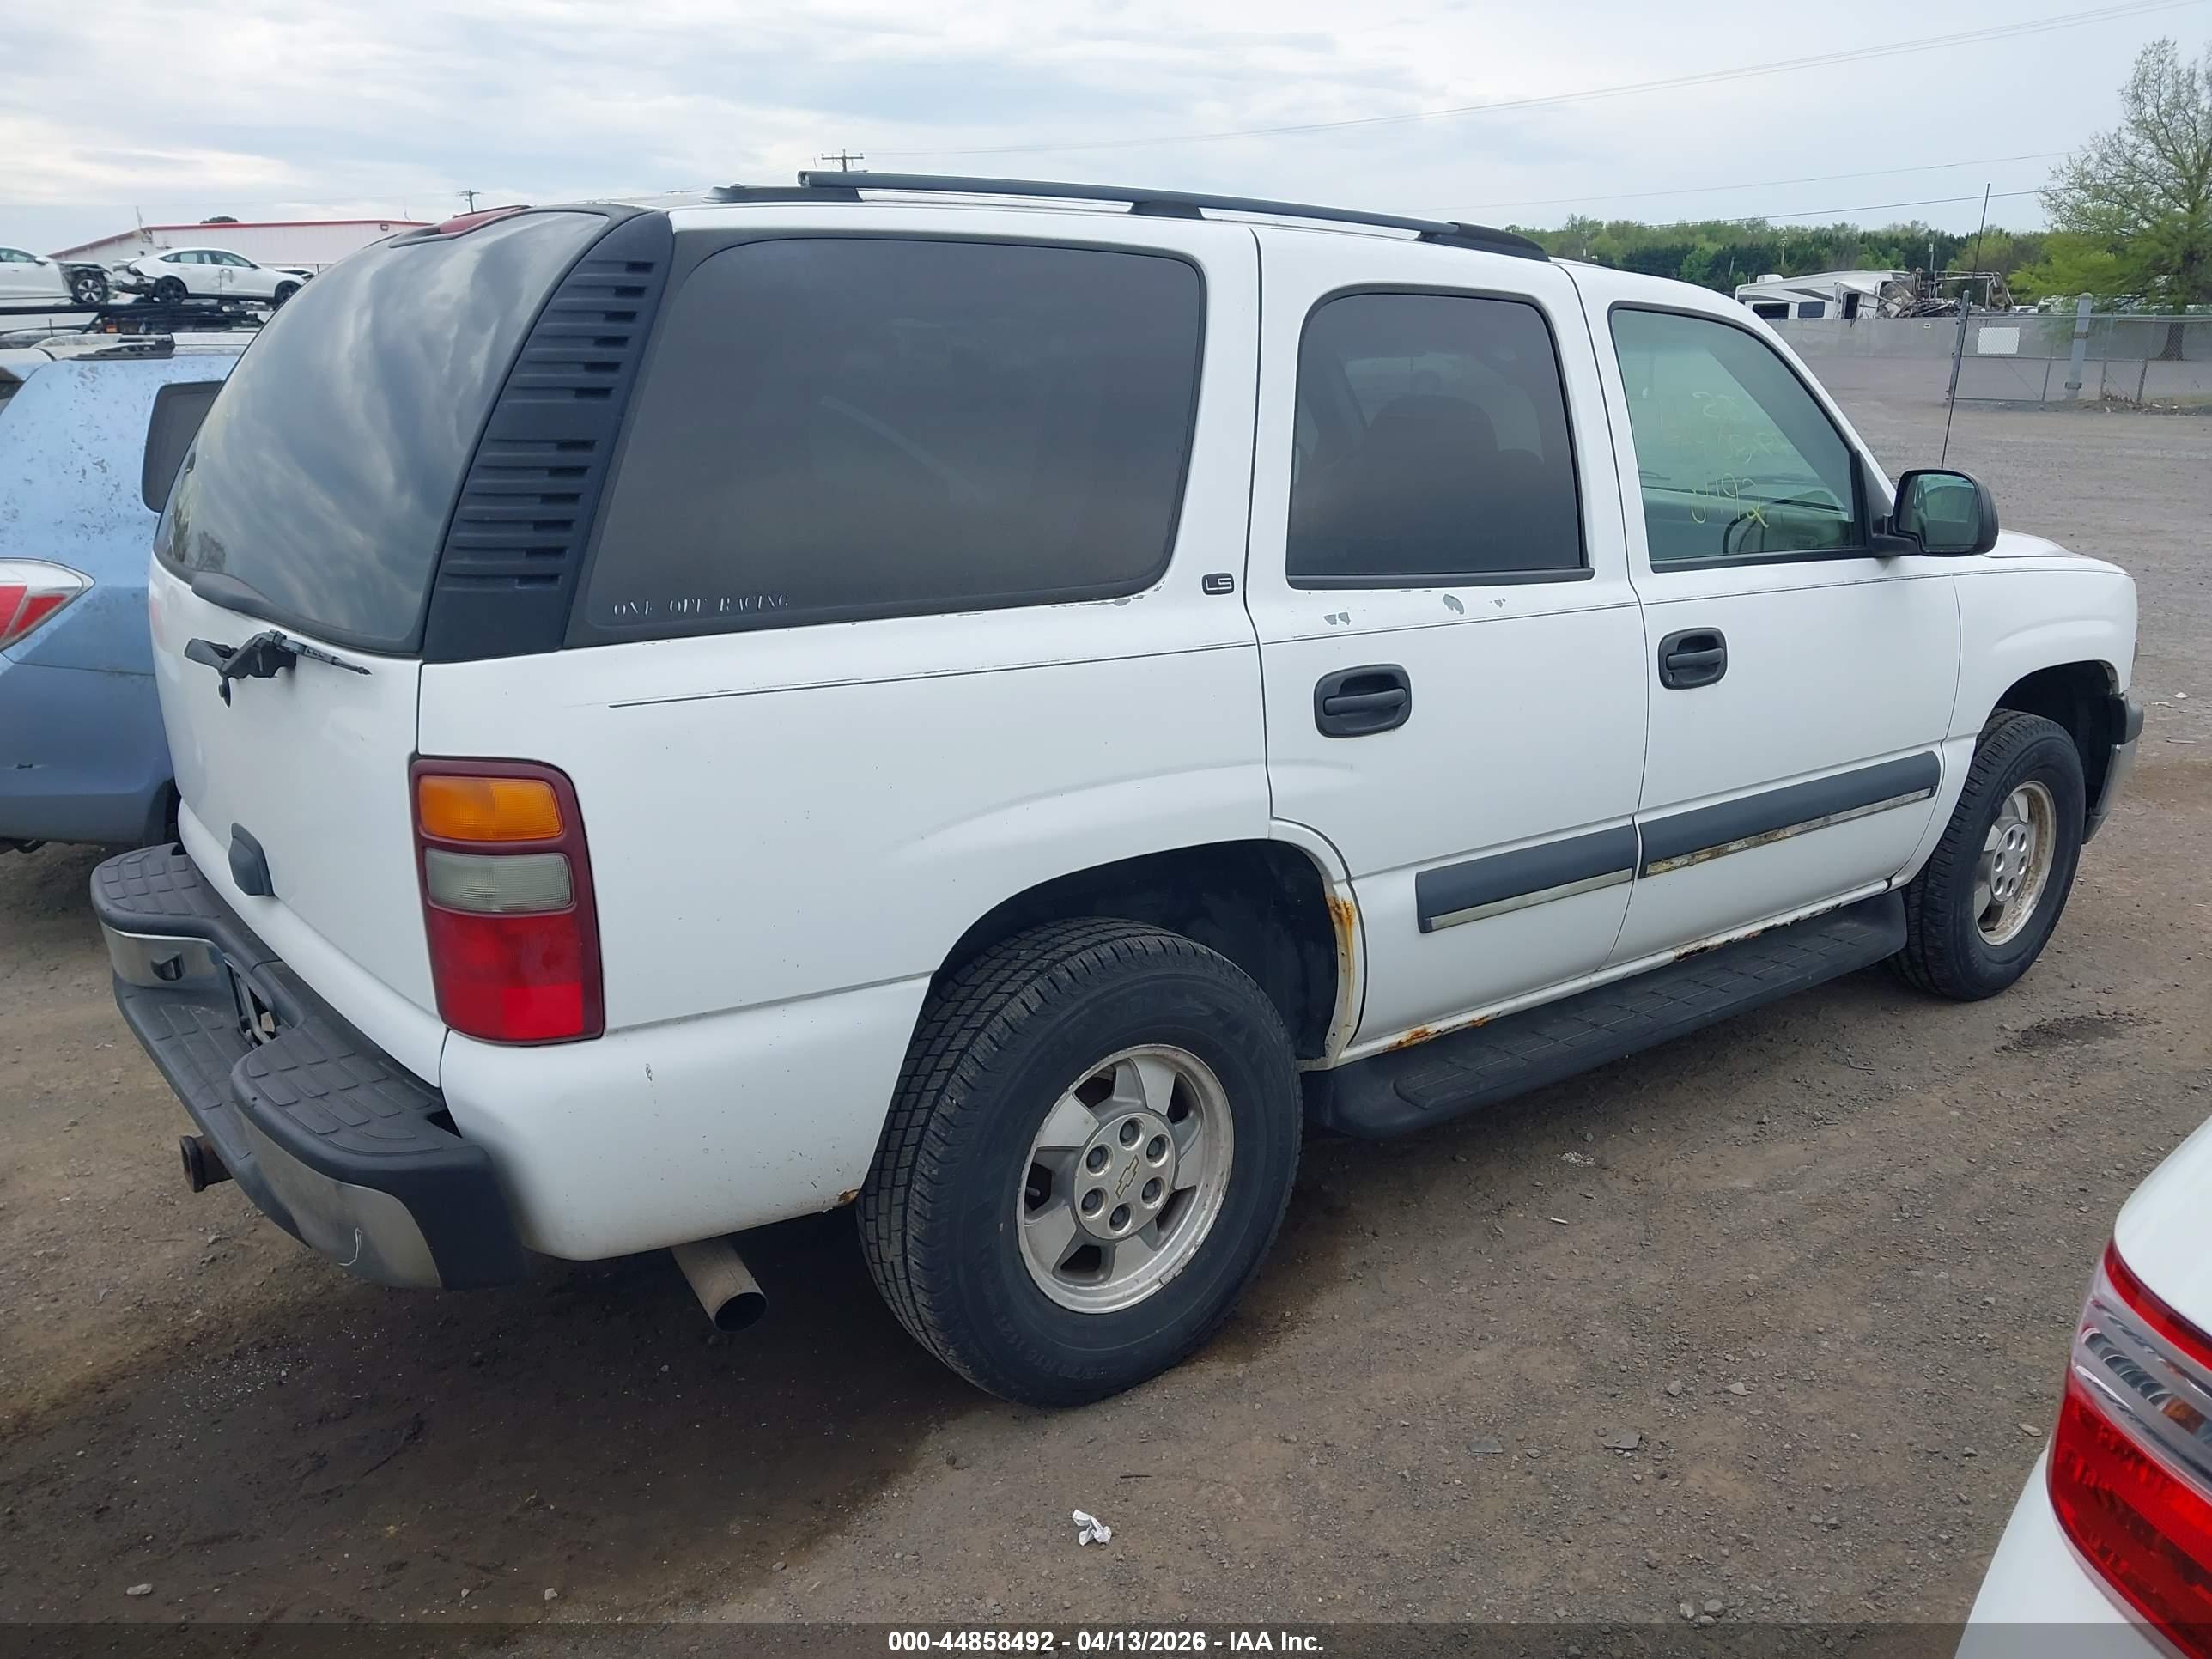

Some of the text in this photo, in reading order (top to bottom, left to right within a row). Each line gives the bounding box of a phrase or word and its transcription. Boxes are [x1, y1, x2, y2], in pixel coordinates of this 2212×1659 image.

[1205, 577, 1232, 592] LS
[613, 599, 653, 616] ONE
[719, 592, 789, 612] RACING
